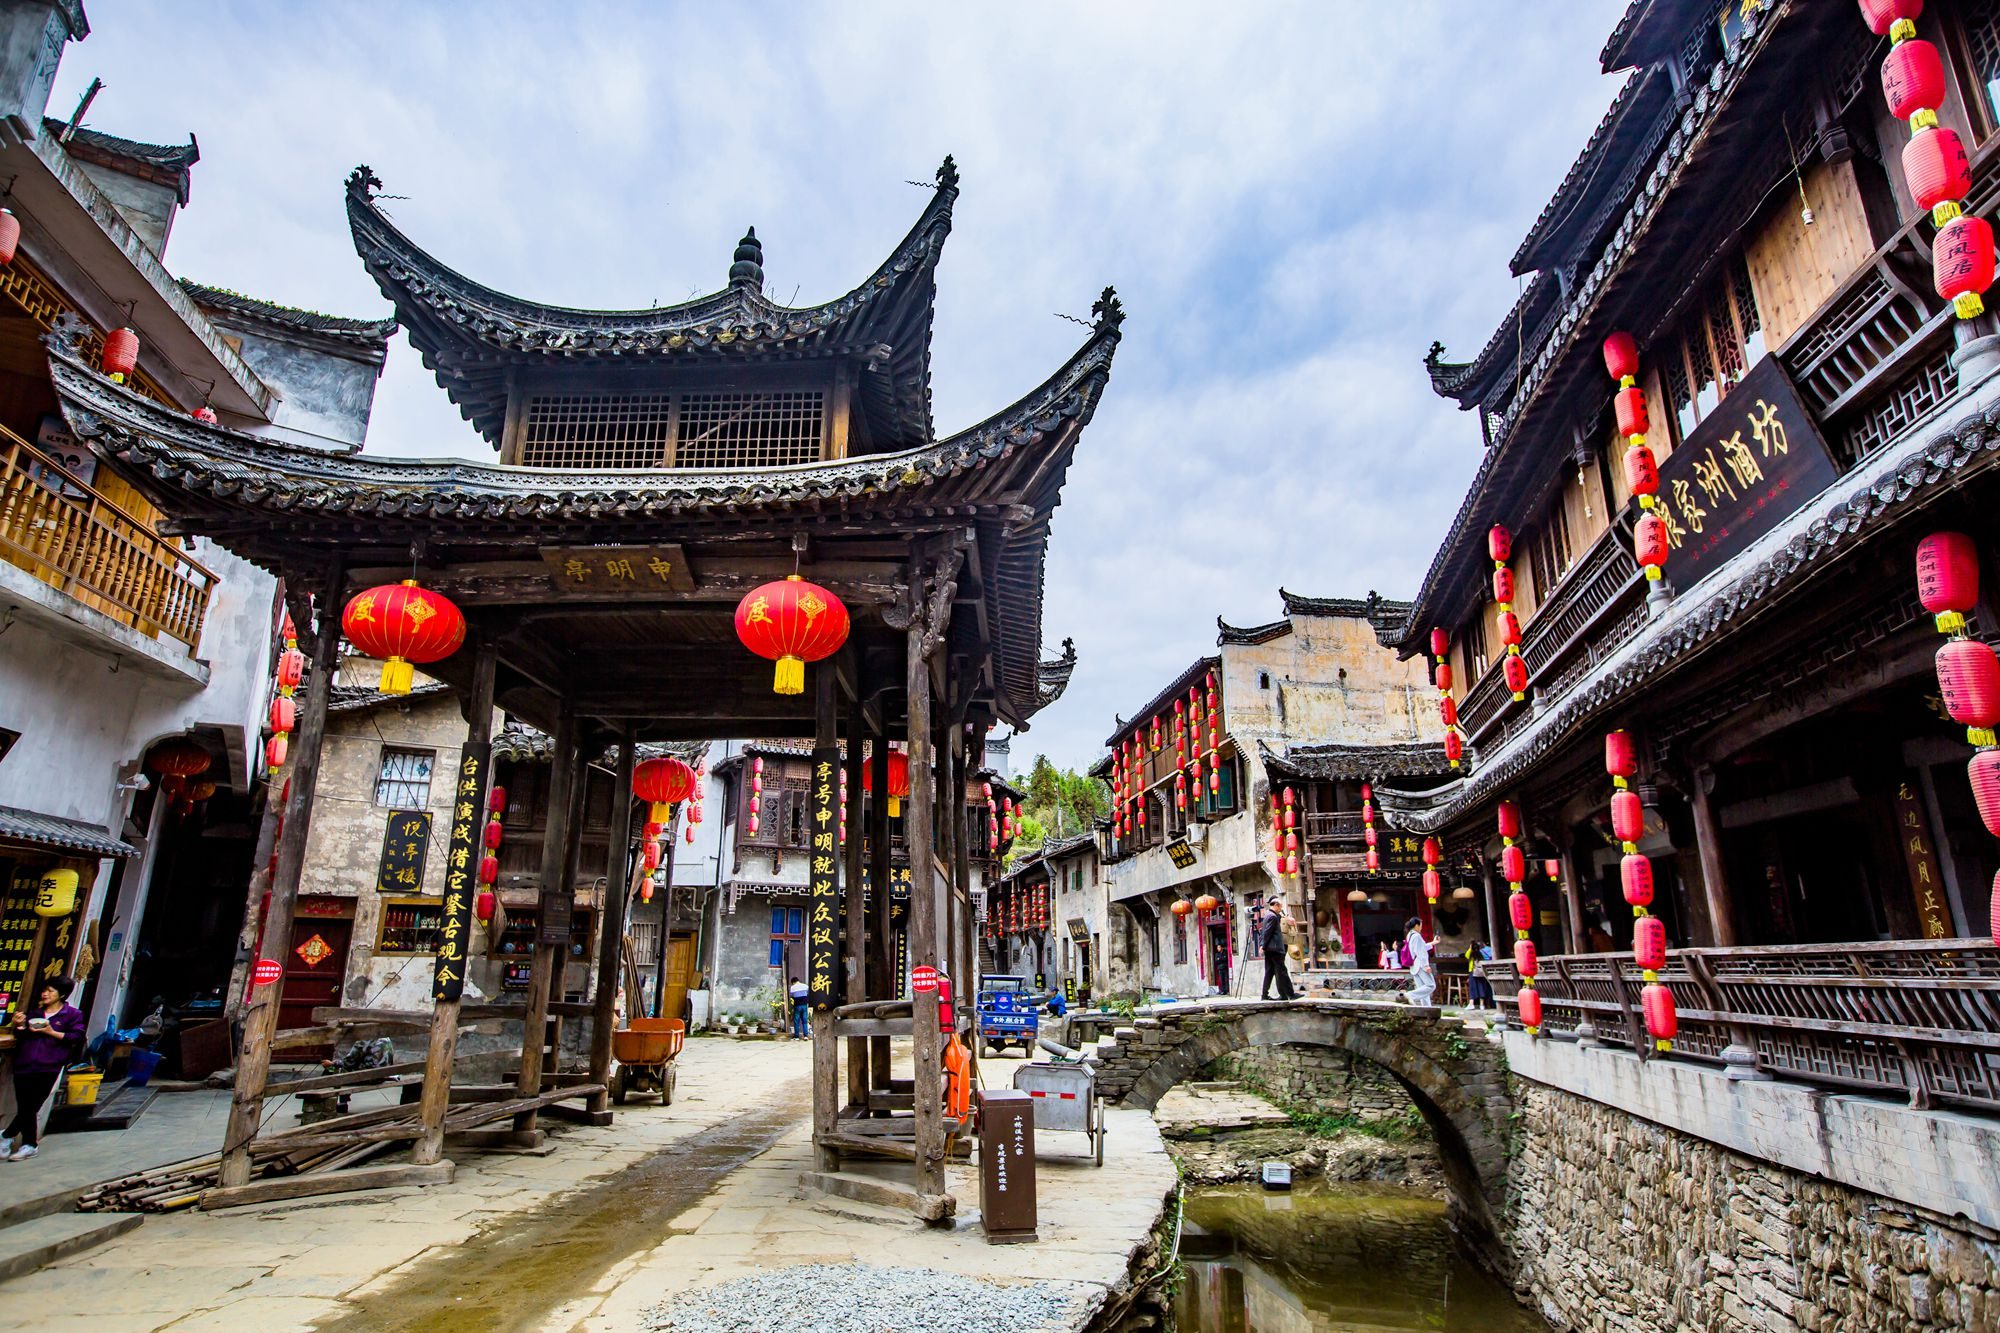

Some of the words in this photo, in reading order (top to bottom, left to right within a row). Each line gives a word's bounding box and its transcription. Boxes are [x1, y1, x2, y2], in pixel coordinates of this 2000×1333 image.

[565, 557, 672, 582] 申明亭
[36, 878, 57, 908] 李记
[810, 761, 836, 996] 亭号申明就此众议公断
